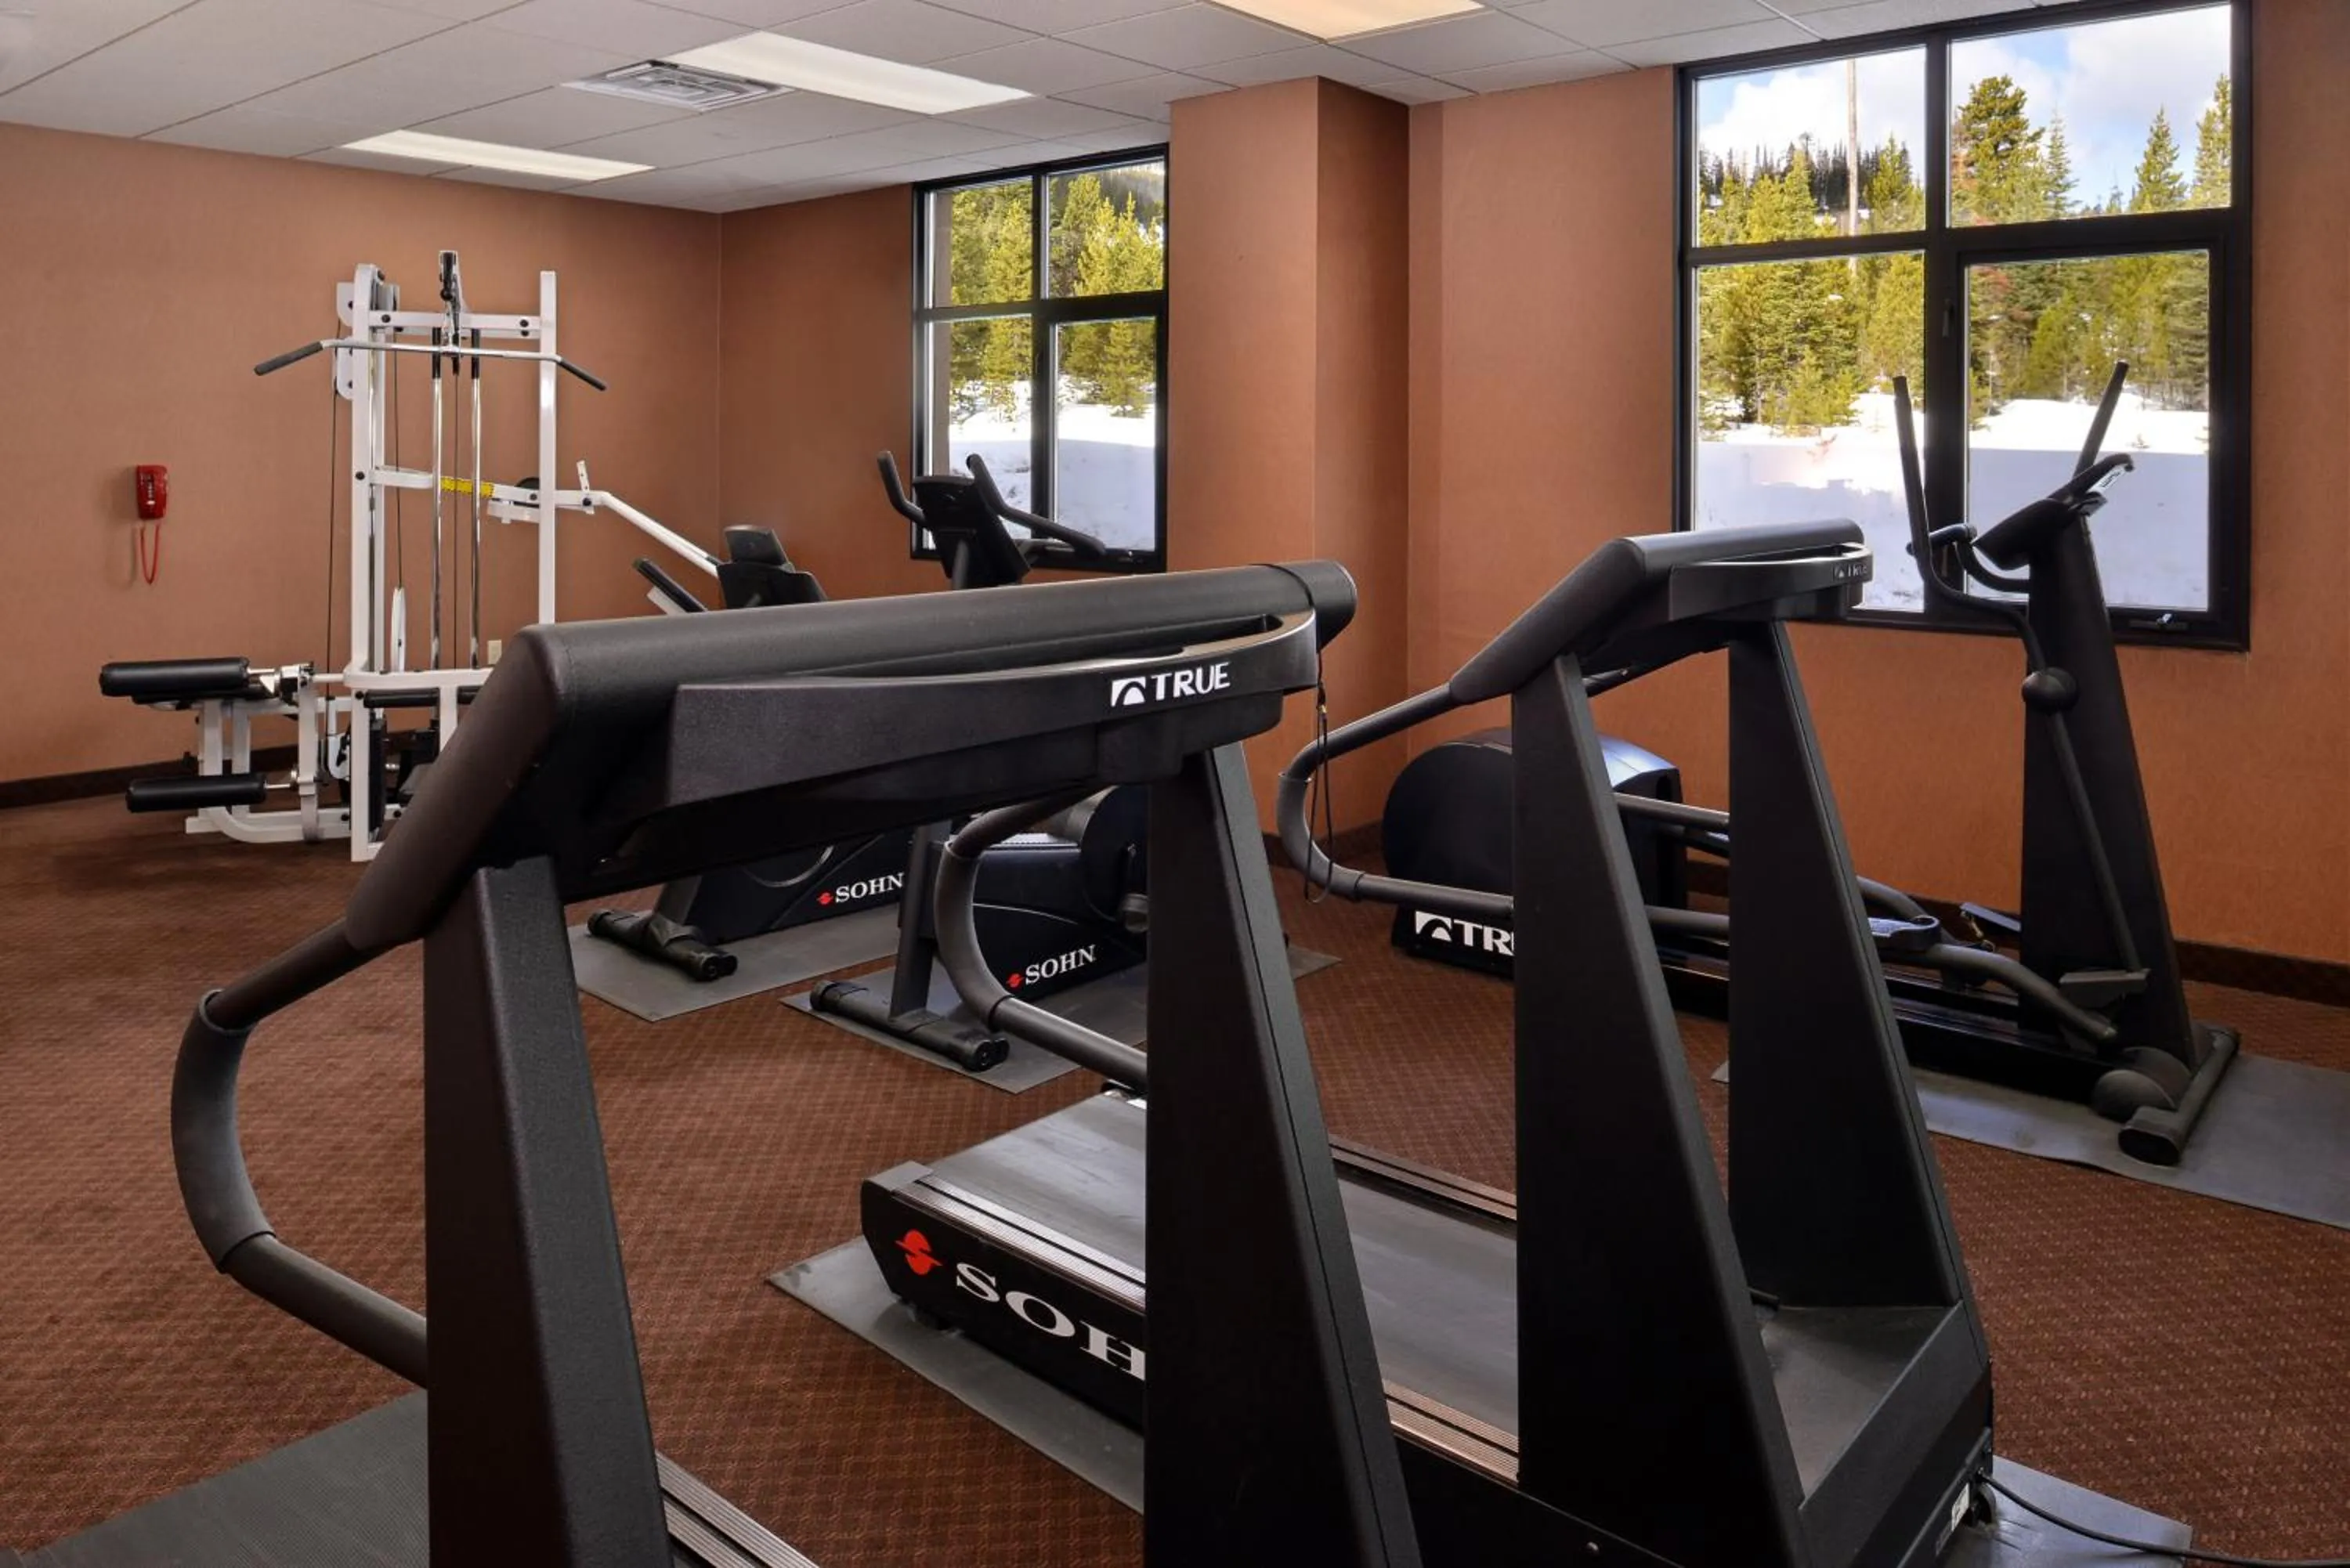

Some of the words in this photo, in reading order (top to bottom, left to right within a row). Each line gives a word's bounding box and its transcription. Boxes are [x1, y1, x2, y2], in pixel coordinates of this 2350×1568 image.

[1151, 662, 1231, 701] TRUE
[836, 873, 904, 903] SOHN
[1453, 919, 1514, 956] TR
[1025, 944, 1097, 985] SOHN
[956, 1263, 1146, 1381] SOH
